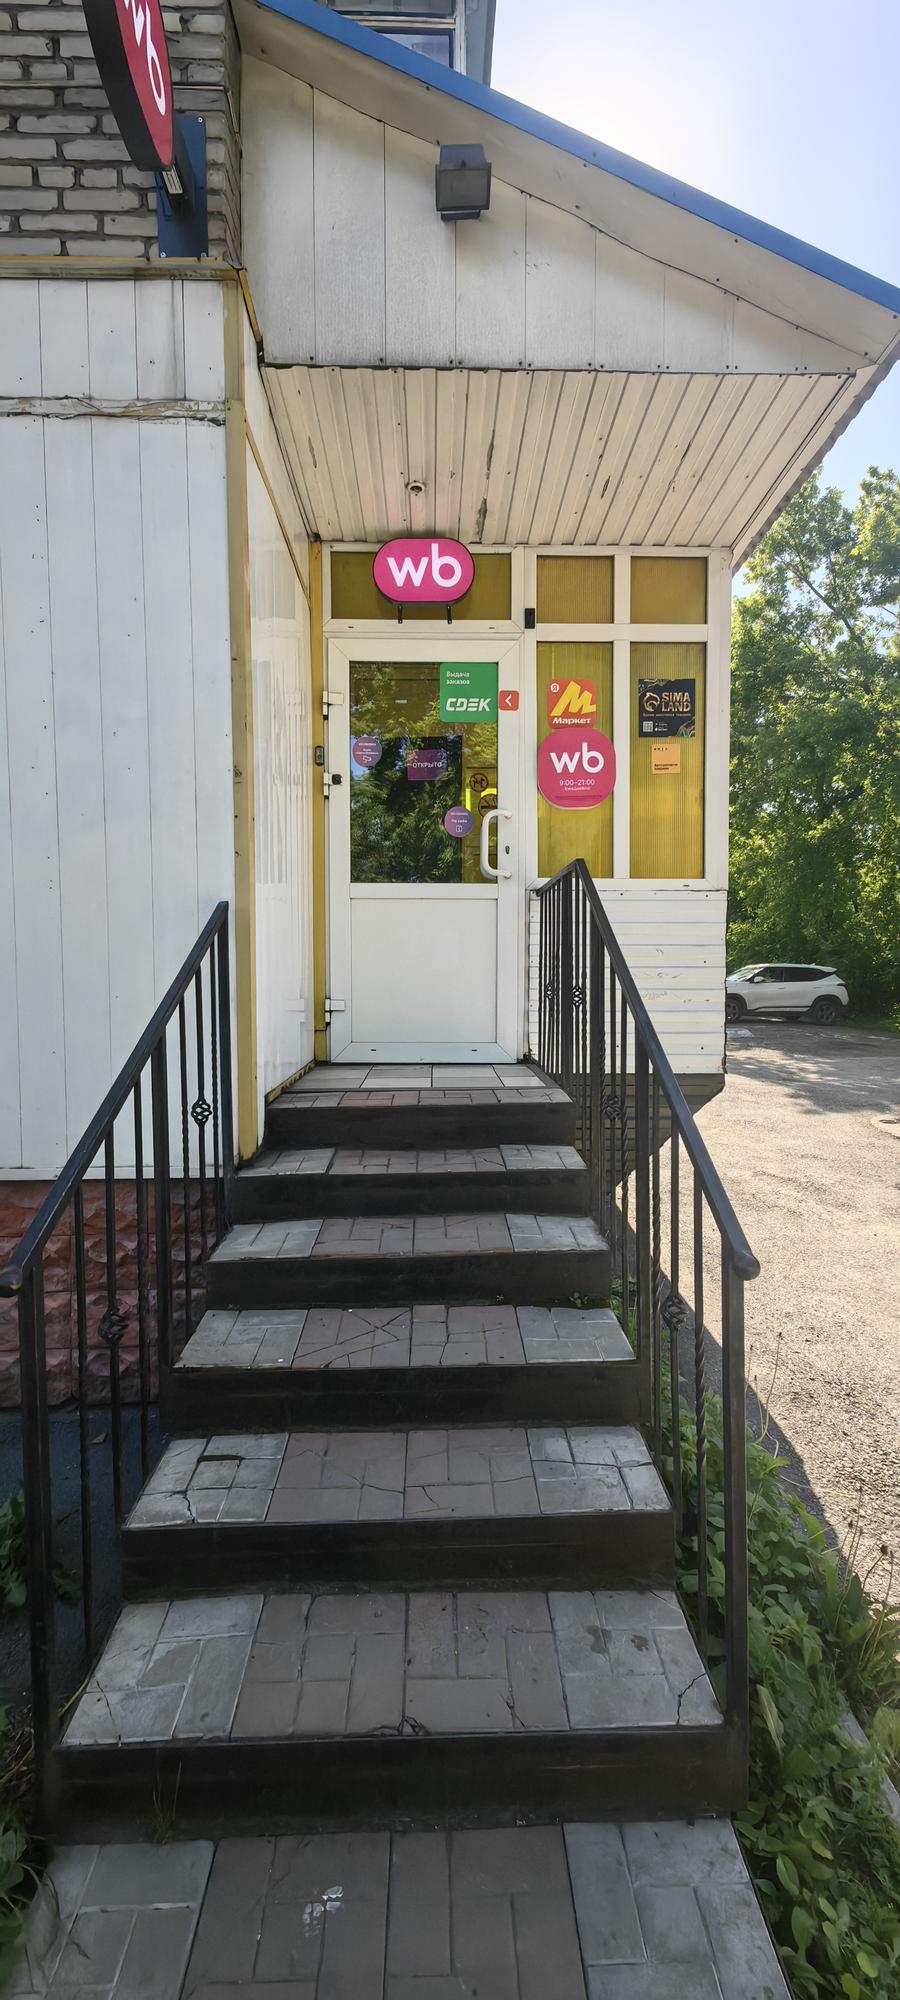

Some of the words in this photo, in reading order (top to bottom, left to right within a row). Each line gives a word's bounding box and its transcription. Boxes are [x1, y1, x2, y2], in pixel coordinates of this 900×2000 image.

[386, 543, 463, 588] wb
[446, 671, 470, 679] Выдача
[661, 692, 690, 702] SIMA
[445, 698, 492, 712] CDEK
[661, 702, 691, 712] LAND
[552, 717, 592, 726] Маркет
[550, 742, 605, 774] wb
[412, 761, 442, 769] ОТКРЫТО
